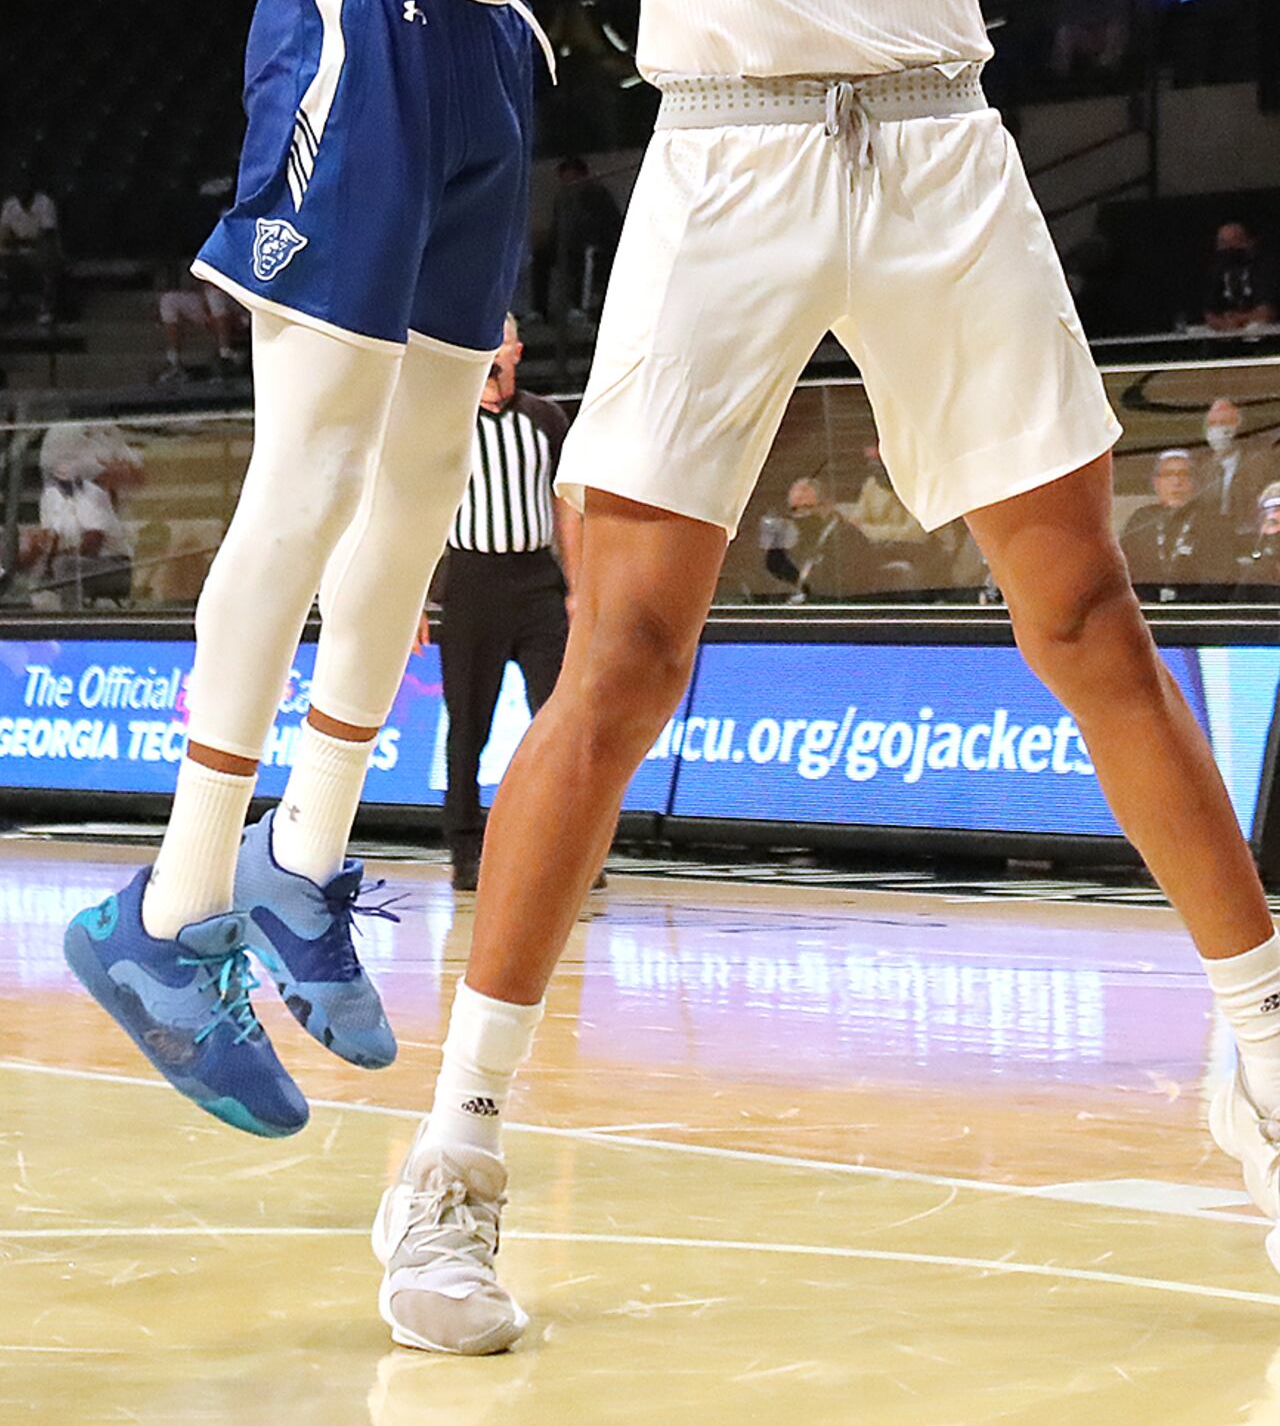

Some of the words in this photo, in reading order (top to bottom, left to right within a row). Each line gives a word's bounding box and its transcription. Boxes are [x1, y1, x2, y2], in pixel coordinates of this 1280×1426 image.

[24, 665, 73, 708] The
[78, 665, 180, 711] Official
[128, 718, 189, 763] TEC
